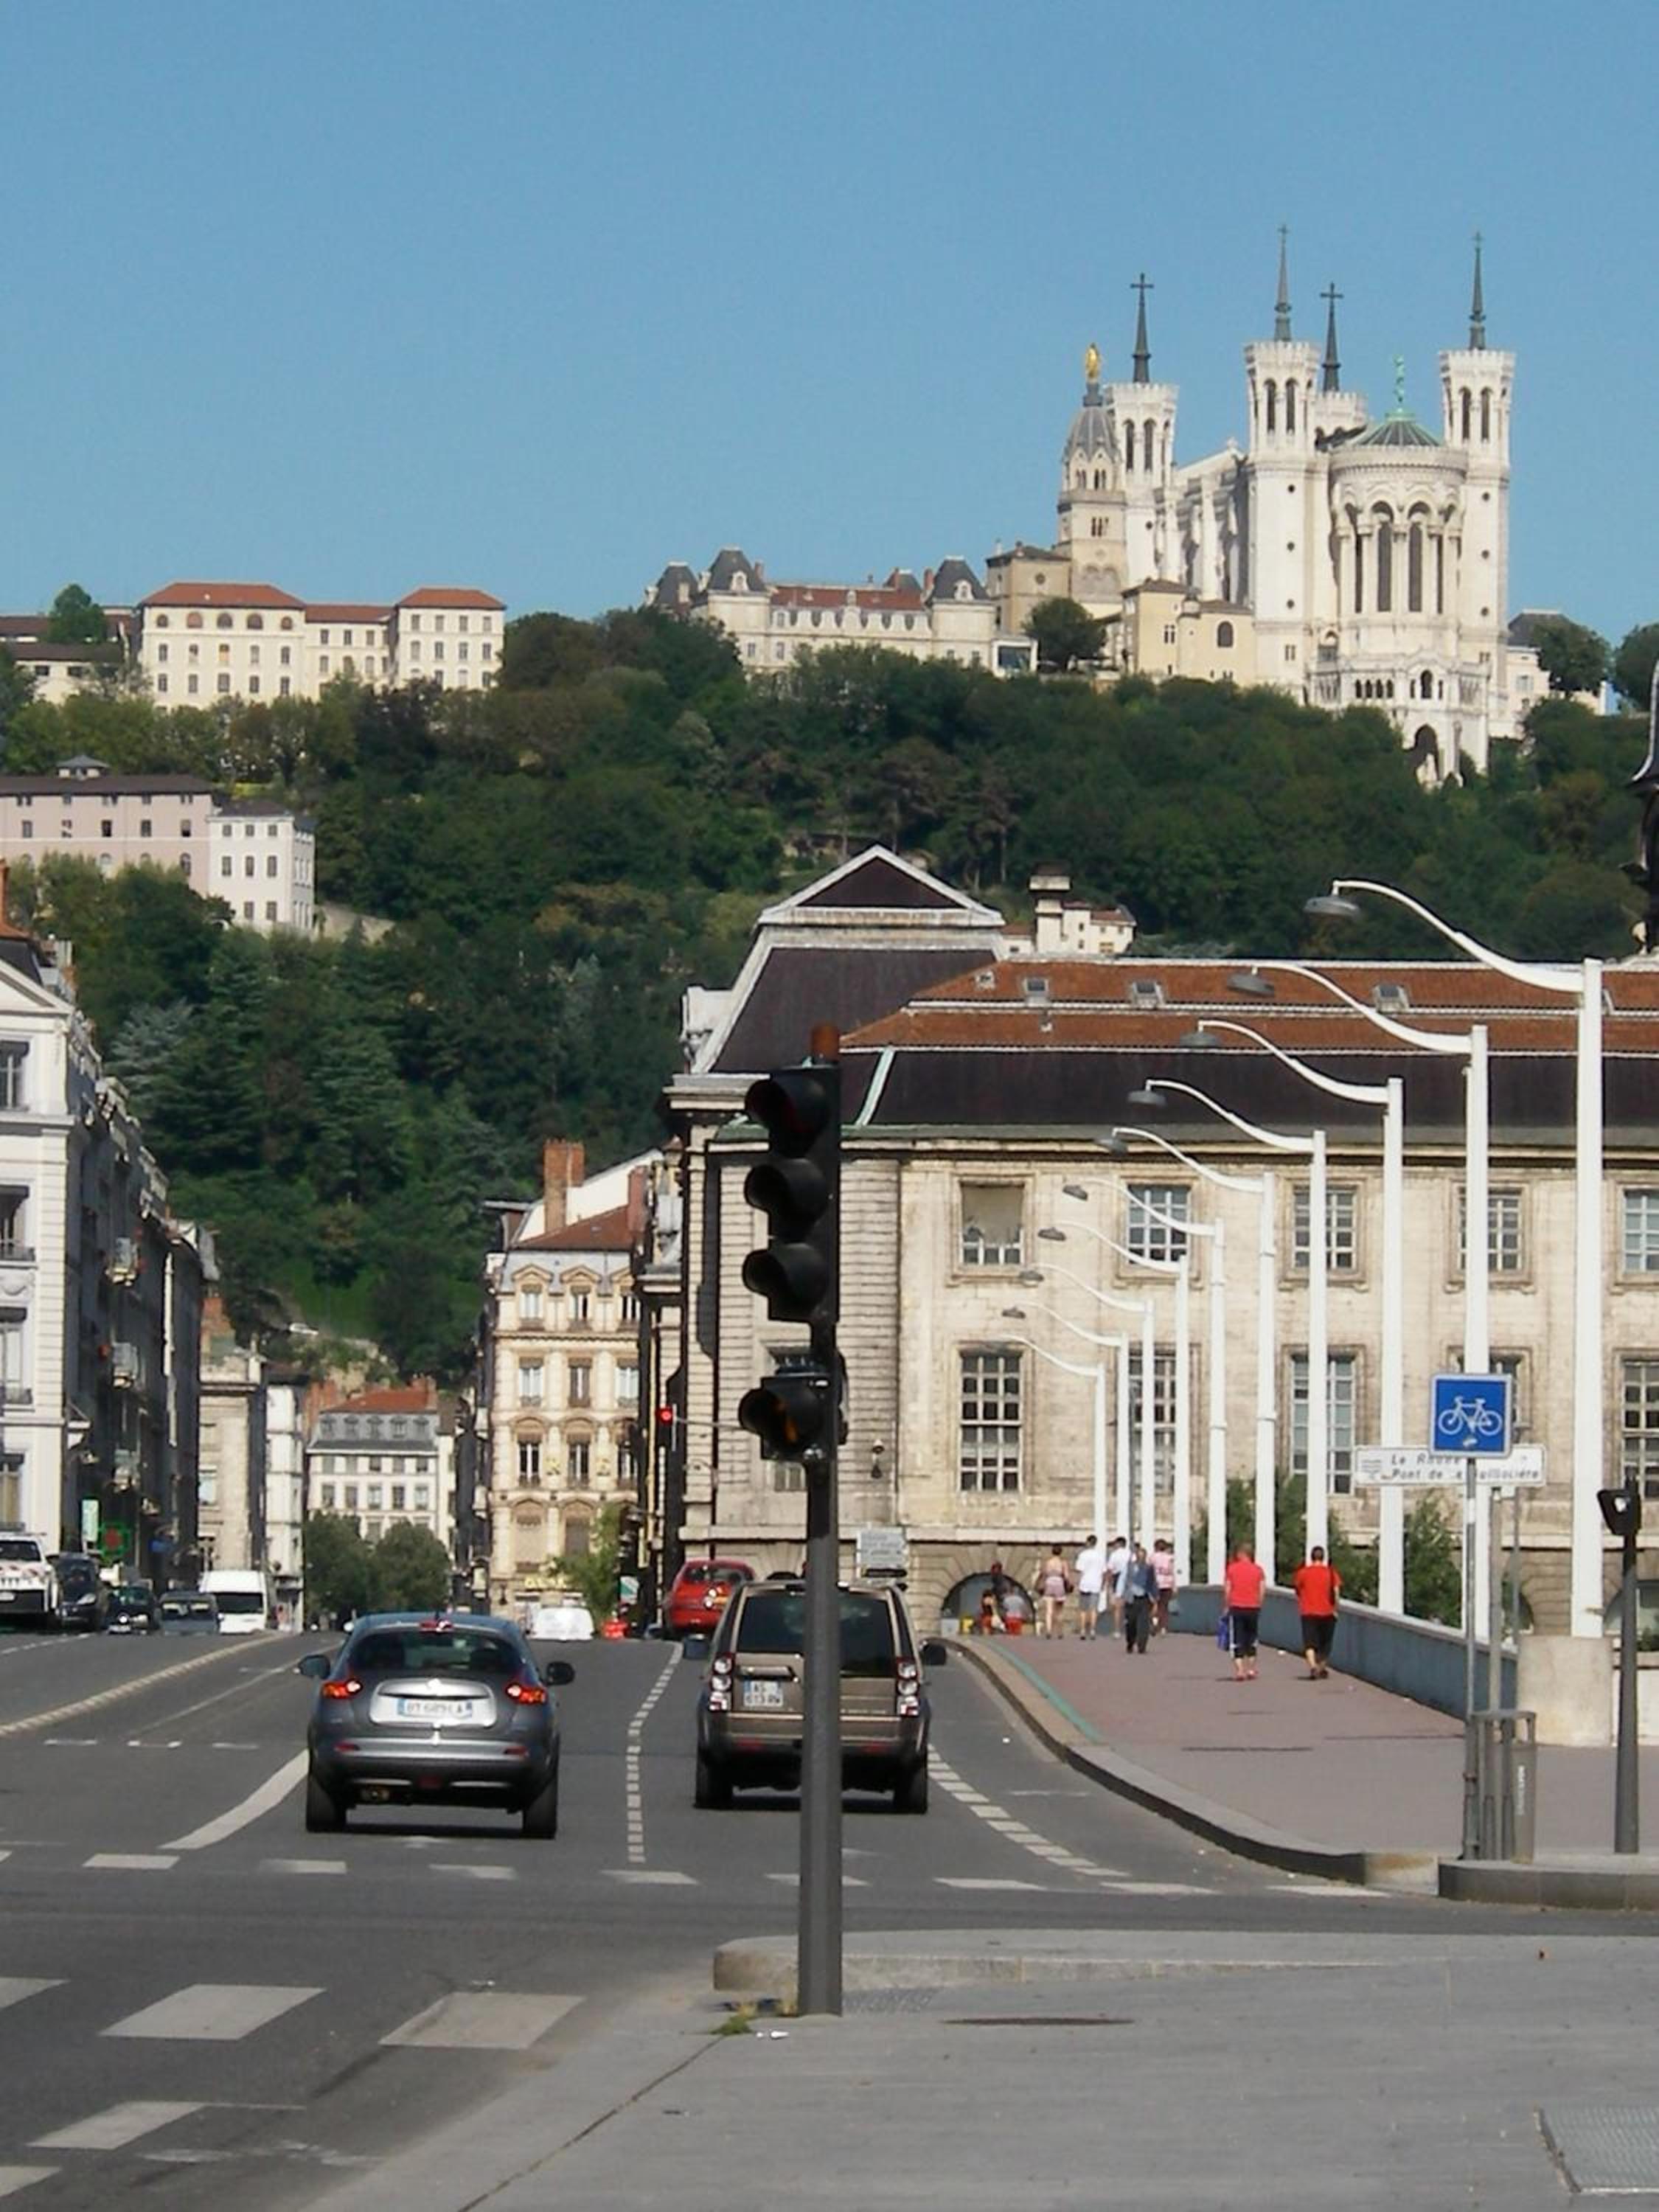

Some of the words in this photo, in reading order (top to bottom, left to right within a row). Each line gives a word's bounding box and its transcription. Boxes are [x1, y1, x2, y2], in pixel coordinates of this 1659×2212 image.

[1391, 1453, 1406, 1465] Le
[1391, 1468, 1422, 1479] Pont
[1428, 1469, 1443, 1479] de
